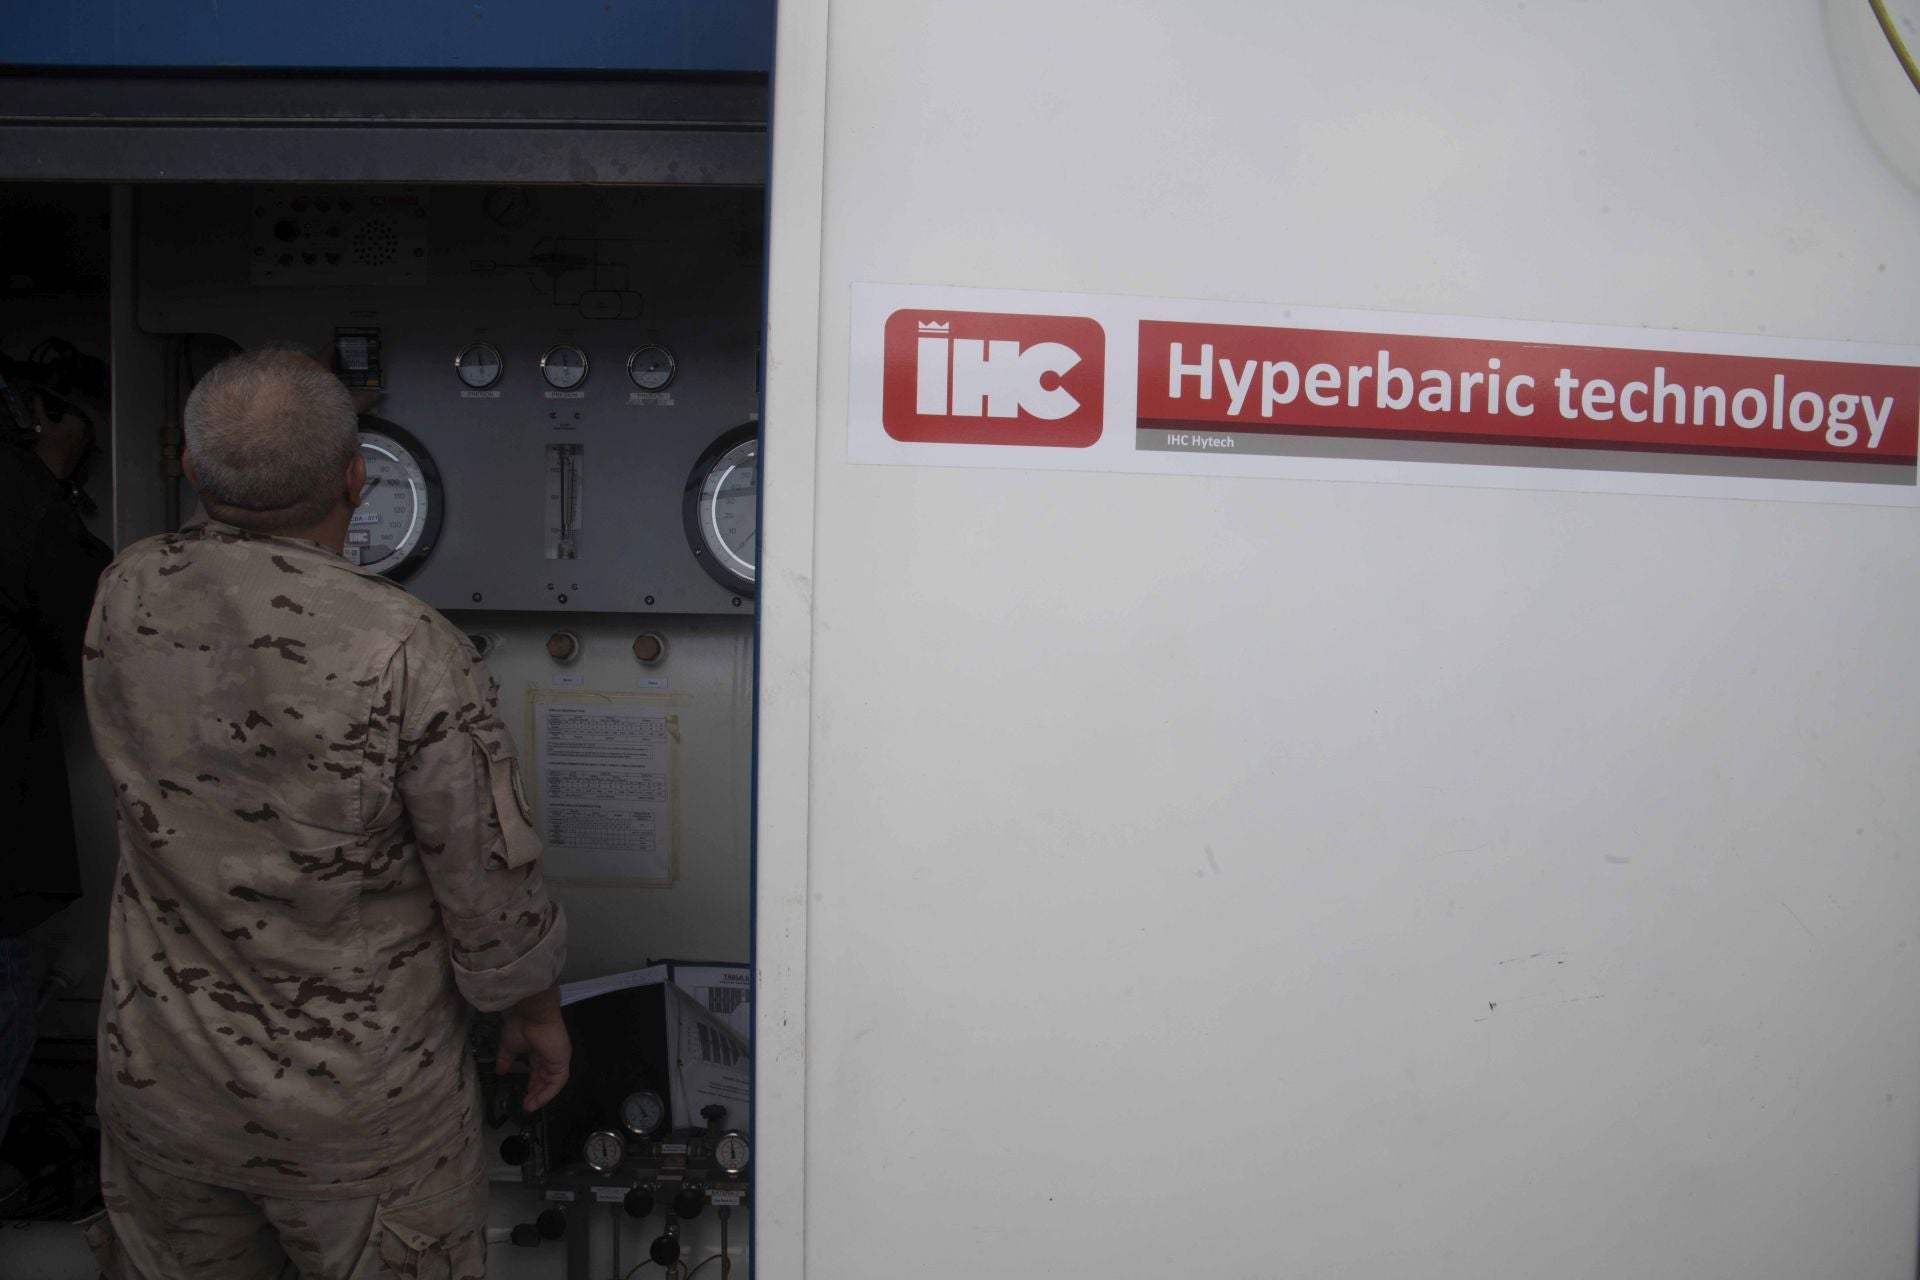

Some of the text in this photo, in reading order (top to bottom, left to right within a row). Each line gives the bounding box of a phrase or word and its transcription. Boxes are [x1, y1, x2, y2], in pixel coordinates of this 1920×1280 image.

[916, 337, 1082, 420] IHC
[1167, 341, 1895, 449] Hyperbaric technology
[1167, 433, 1235, 449] IHC Hytech
